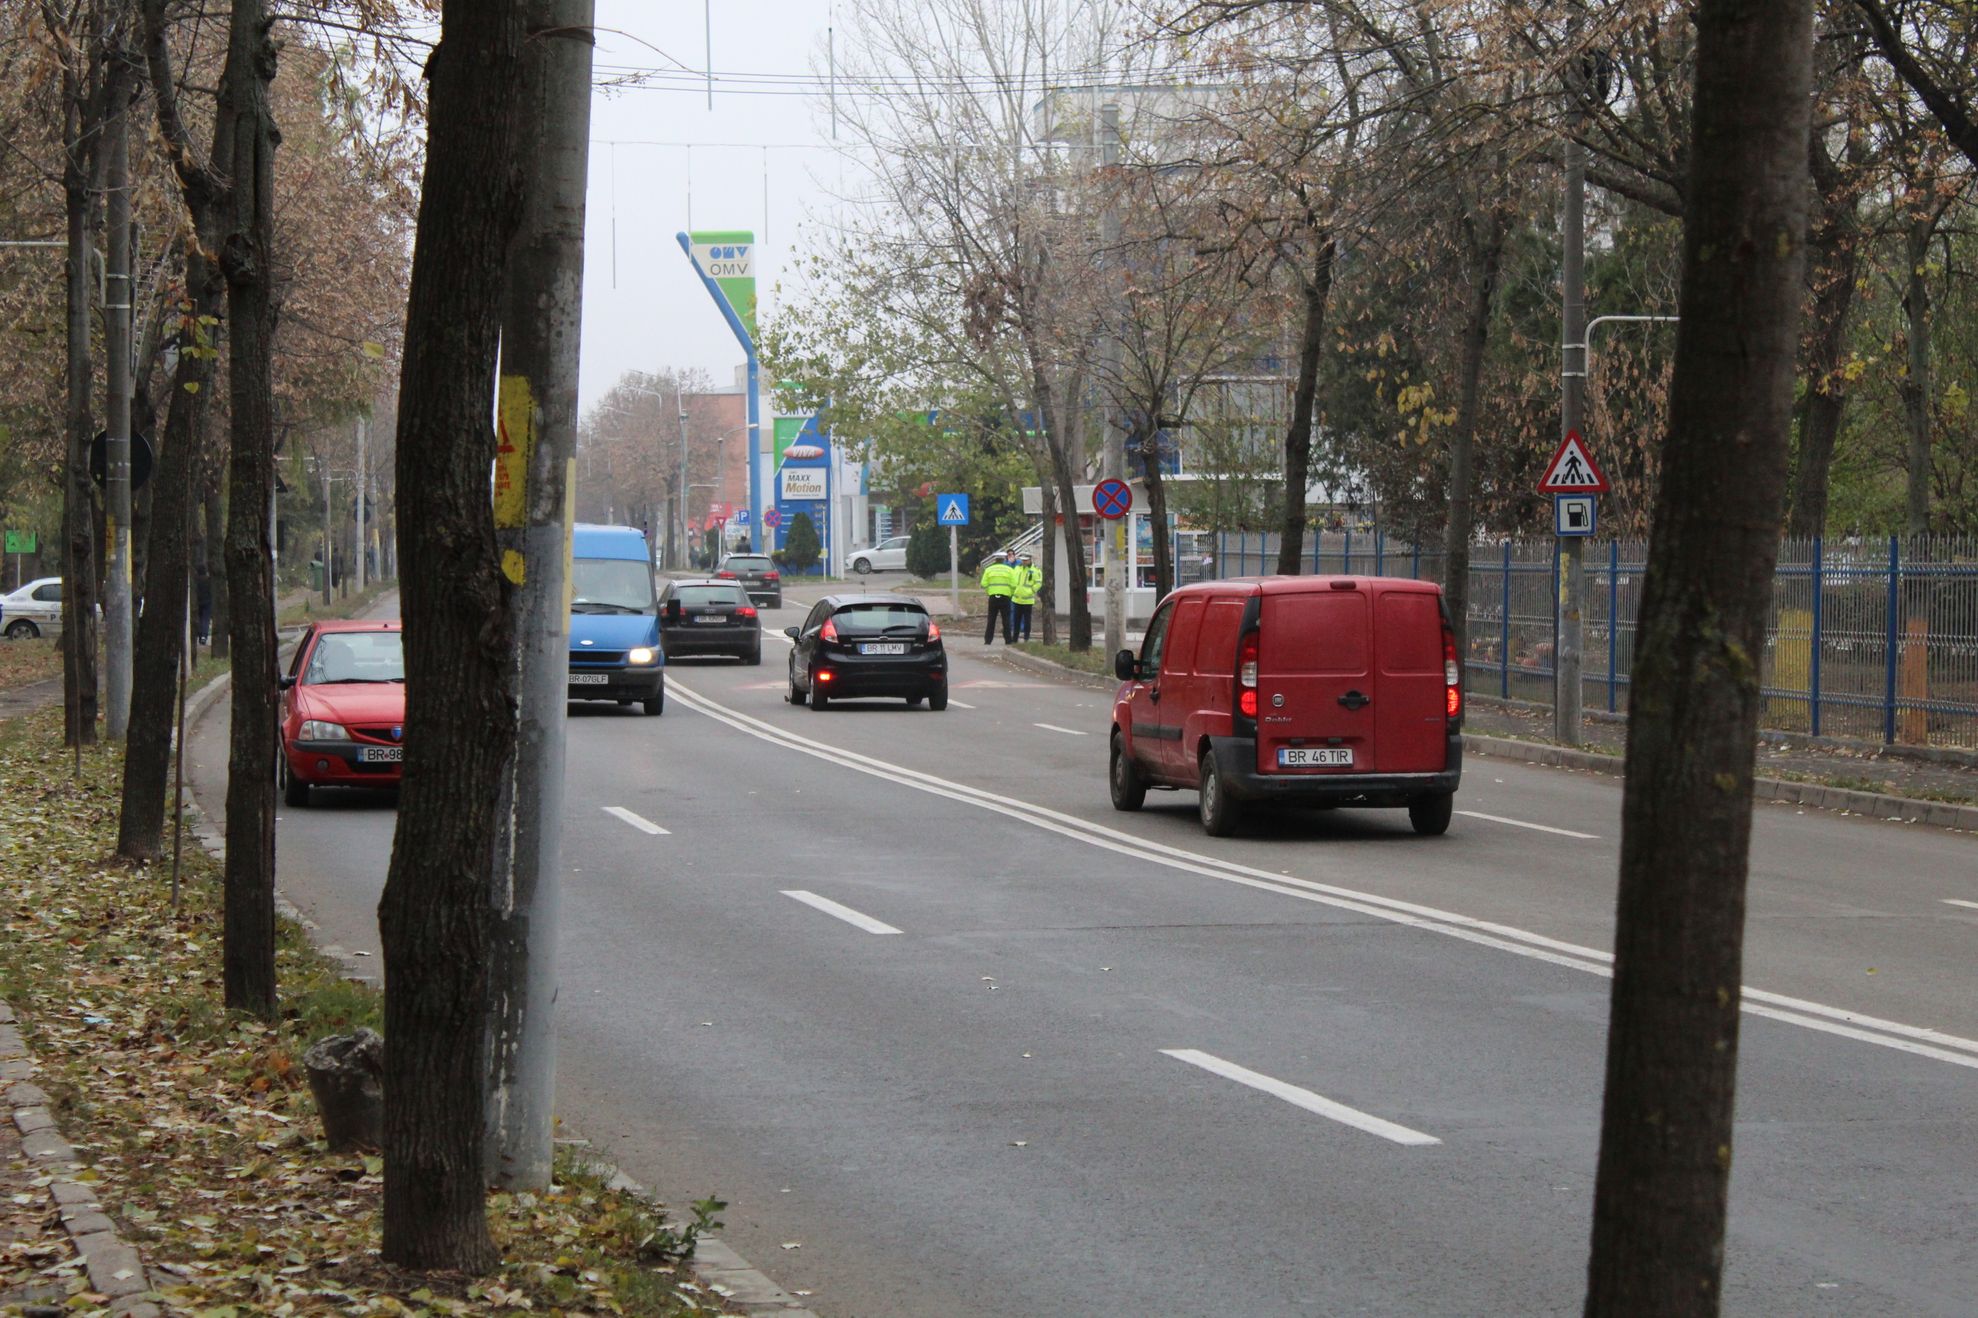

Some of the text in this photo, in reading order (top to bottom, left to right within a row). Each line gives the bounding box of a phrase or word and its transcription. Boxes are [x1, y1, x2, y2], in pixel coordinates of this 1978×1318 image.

[710, 263, 748, 276] OMV
[792, 447, 817, 458] VIVA
[788, 474, 811, 482] MAXX
[785, 482, 821, 493] Motion
[740, 511, 748, 521] P
[1288, 750, 1349, 763] BR 46 TIR
